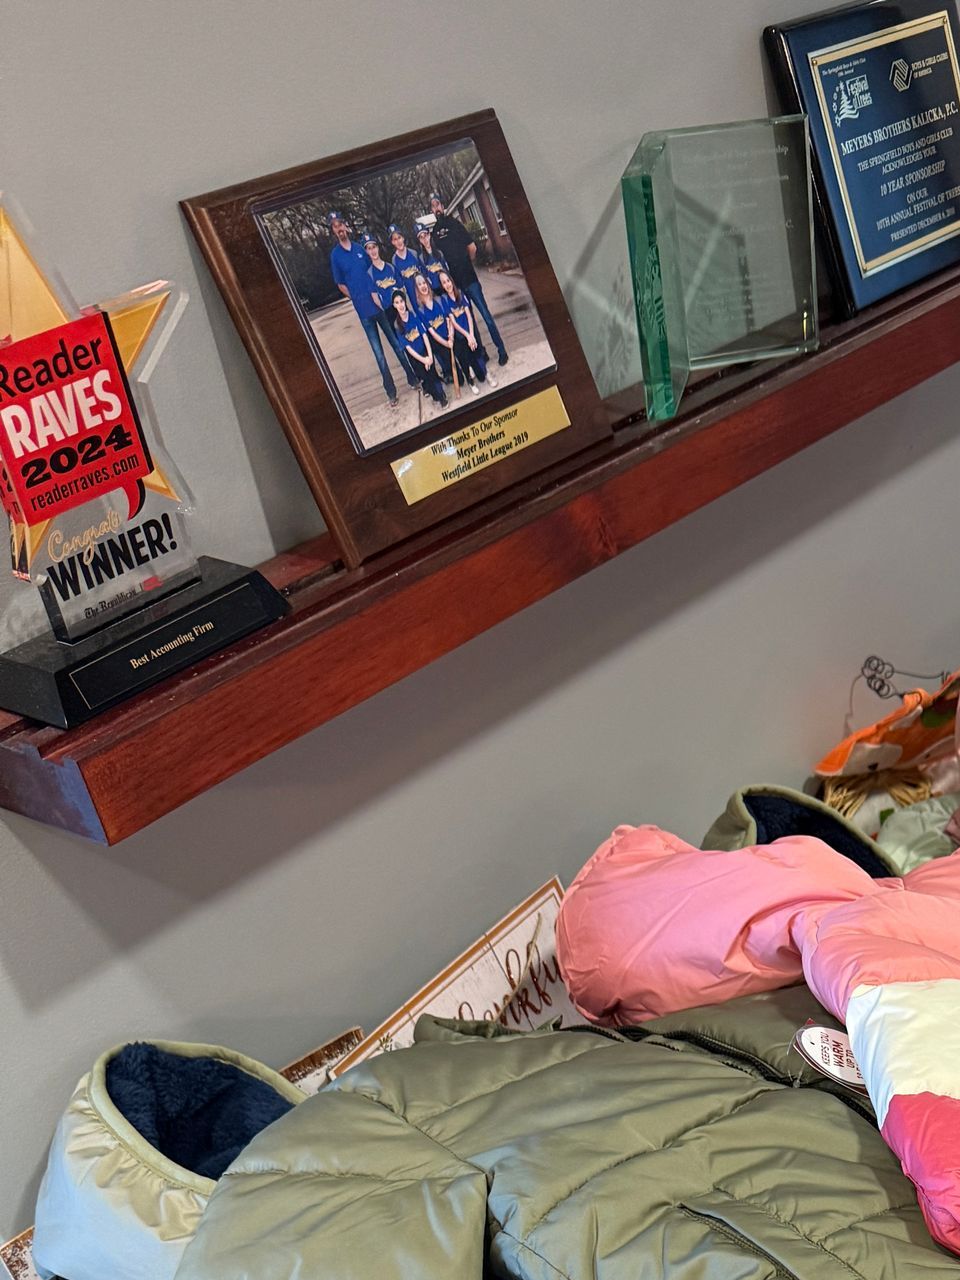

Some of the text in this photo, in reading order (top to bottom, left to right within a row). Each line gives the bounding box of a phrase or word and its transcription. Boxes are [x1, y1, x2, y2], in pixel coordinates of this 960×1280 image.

[846, 77, 869, 97] Festival
[841, 101, 959, 156] MEYERS BROTHERS KALICKA, P.C.
[857, 127, 953, 172] THE SPRINGFIELD BOYS AND GIRLS CLUB
[882, 145, 937, 175] ACKNOWLEDGES YOUR
[887, 177, 905, 193] YEAR
[904, 160, 946, 186] SPONSORSHIP
[890, 207, 914, 225] ANNUAL
[913, 196, 938, 215] FESTIVAL
[938, 192, 945, 204] OF
[906, 187, 929, 204] ON OUR
[890, 223, 918, 242] PRESENTED
[0, 337, 103, 398] Reader
[1, 369, 123, 459] RAVES
[431, 408, 519, 457] With Thanks To Our Sponsor
[456, 430, 506, 460] Meyer Brothers
[21, 424, 133, 489] 2024
[441, 431, 529, 482] Westfield Little League 2019
[31, 453, 140, 512] readerraves.com
[46, 512, 178, 602] WINNER!
[84, 588, 138, 620] The Republican
[130, 621, 215, 670] Best Accounting Firm
[820, 1031, 831, 1067] KEEPS YOU
[832, 1039, 845, 1068] WARM
[846, 1058, 855, 1069] UP
